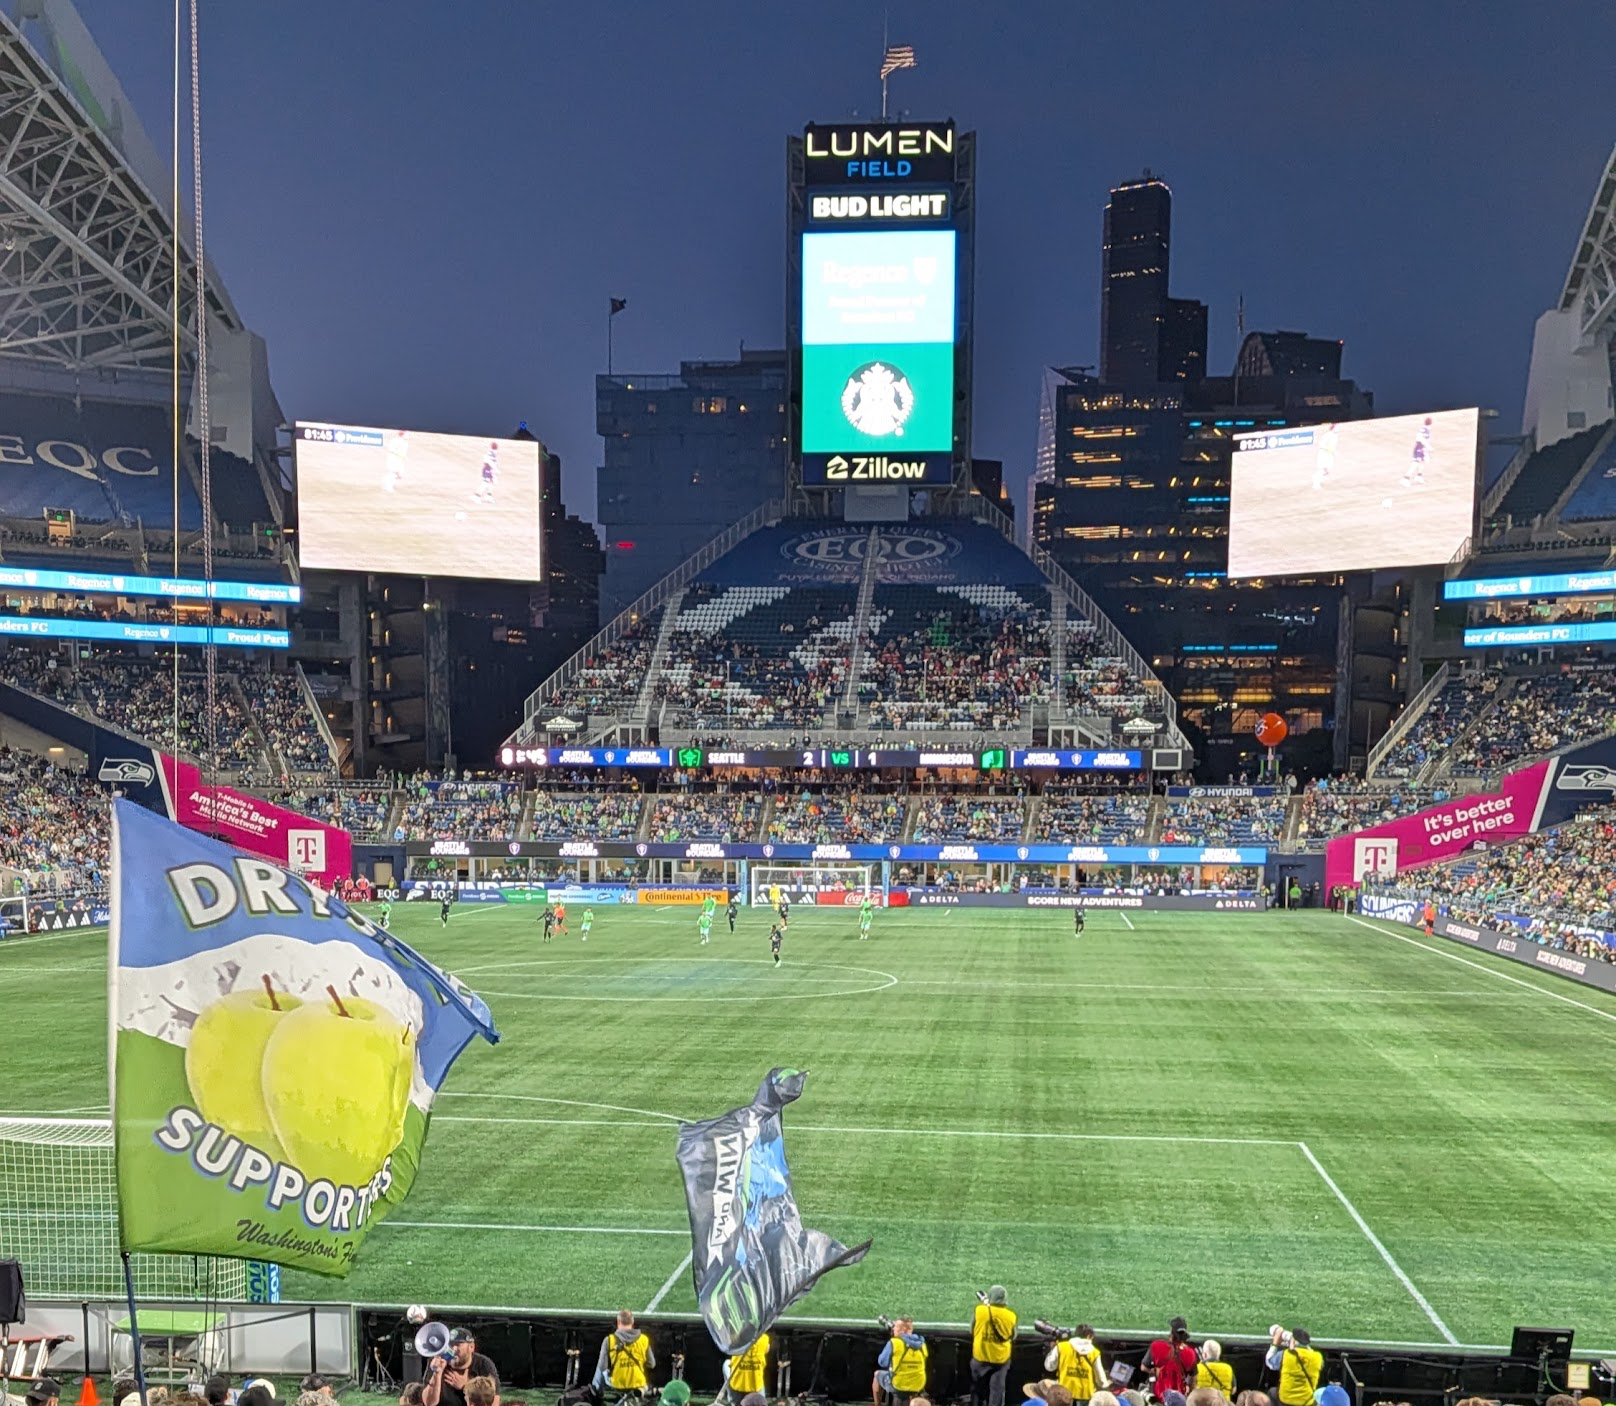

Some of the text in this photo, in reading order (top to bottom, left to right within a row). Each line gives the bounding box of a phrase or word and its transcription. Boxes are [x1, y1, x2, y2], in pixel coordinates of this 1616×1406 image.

[806, 128, 953, 157] LUMEN
[847, 160, 912, 177] FIELD
[812, 194, 946, 218] BUD LIGHT
[304, 428, 333, 441] 81:45
[0, 434, 160, 483] EQC
[851, 456, 927, 479] Zillow
[816, 538, 938, 563] EQC
[160, 581, 203, 596] Regence
[247, 586, 287, 601] Regence
[124, 627, 158, 639] Regence
[227, 631, 261, 643] Proud
[1483, 631, 1497, 643] of
[1497, 630, 1550, 643] Sounders
[1552, 628, 1570, 639] FC
[708, 752, 975, 766] SEATTLE 2 VS 1 MINNESOTA
[217, 792, 247, 808] T-Mobile
[1207, 788, 1253, 797] HYUNDAI
[250, 811, 278, 829] Best
[1424, 796, 1513, 832] It's better
[228, 815, 265, 833] Network
[1430, 812, 1515, 846] over here
[377, 888, 400, 899] EQC
[431, 888, 454, 898] EQC
[645, 890, 694, 903] Continental
[844, 891, 880, 906] Cocala
[928, 895, 959, 903] DELTA
[1027, 896, 1143, 907] SCORE NEW ADVENTURES
[1225, 899, 1257, 908] DELTA
[236, 1217, 339, 1260] Washington's
